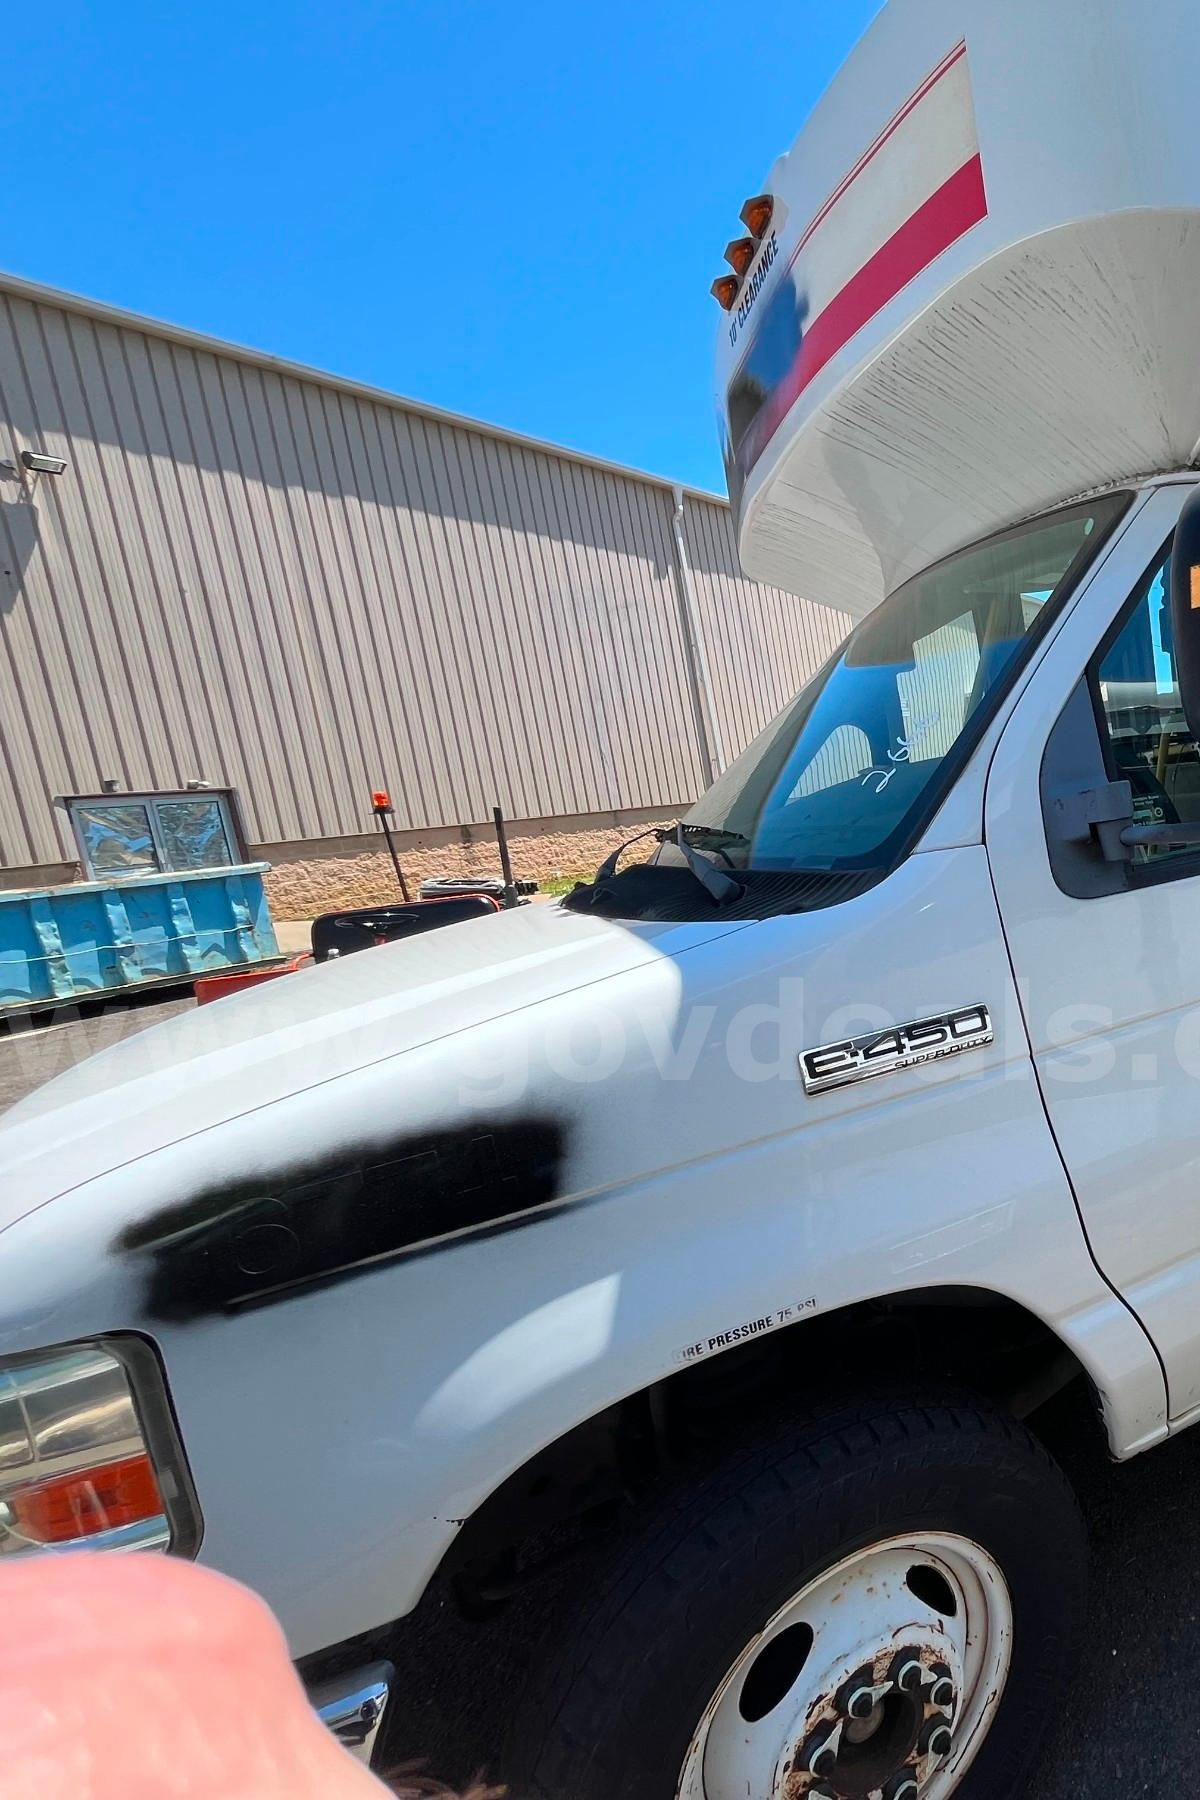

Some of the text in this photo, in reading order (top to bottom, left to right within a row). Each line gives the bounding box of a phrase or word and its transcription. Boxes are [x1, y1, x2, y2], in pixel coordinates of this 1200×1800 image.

[738, 229, 779, 329] CLEARANCE
[894, 1036, 993, 1070] SUPER DUTY
[708, 1315, 774, 1351] PRESSURE
[776, 1307, 793, 1323] 75
[797, 1298, 817, 1313] PSI
